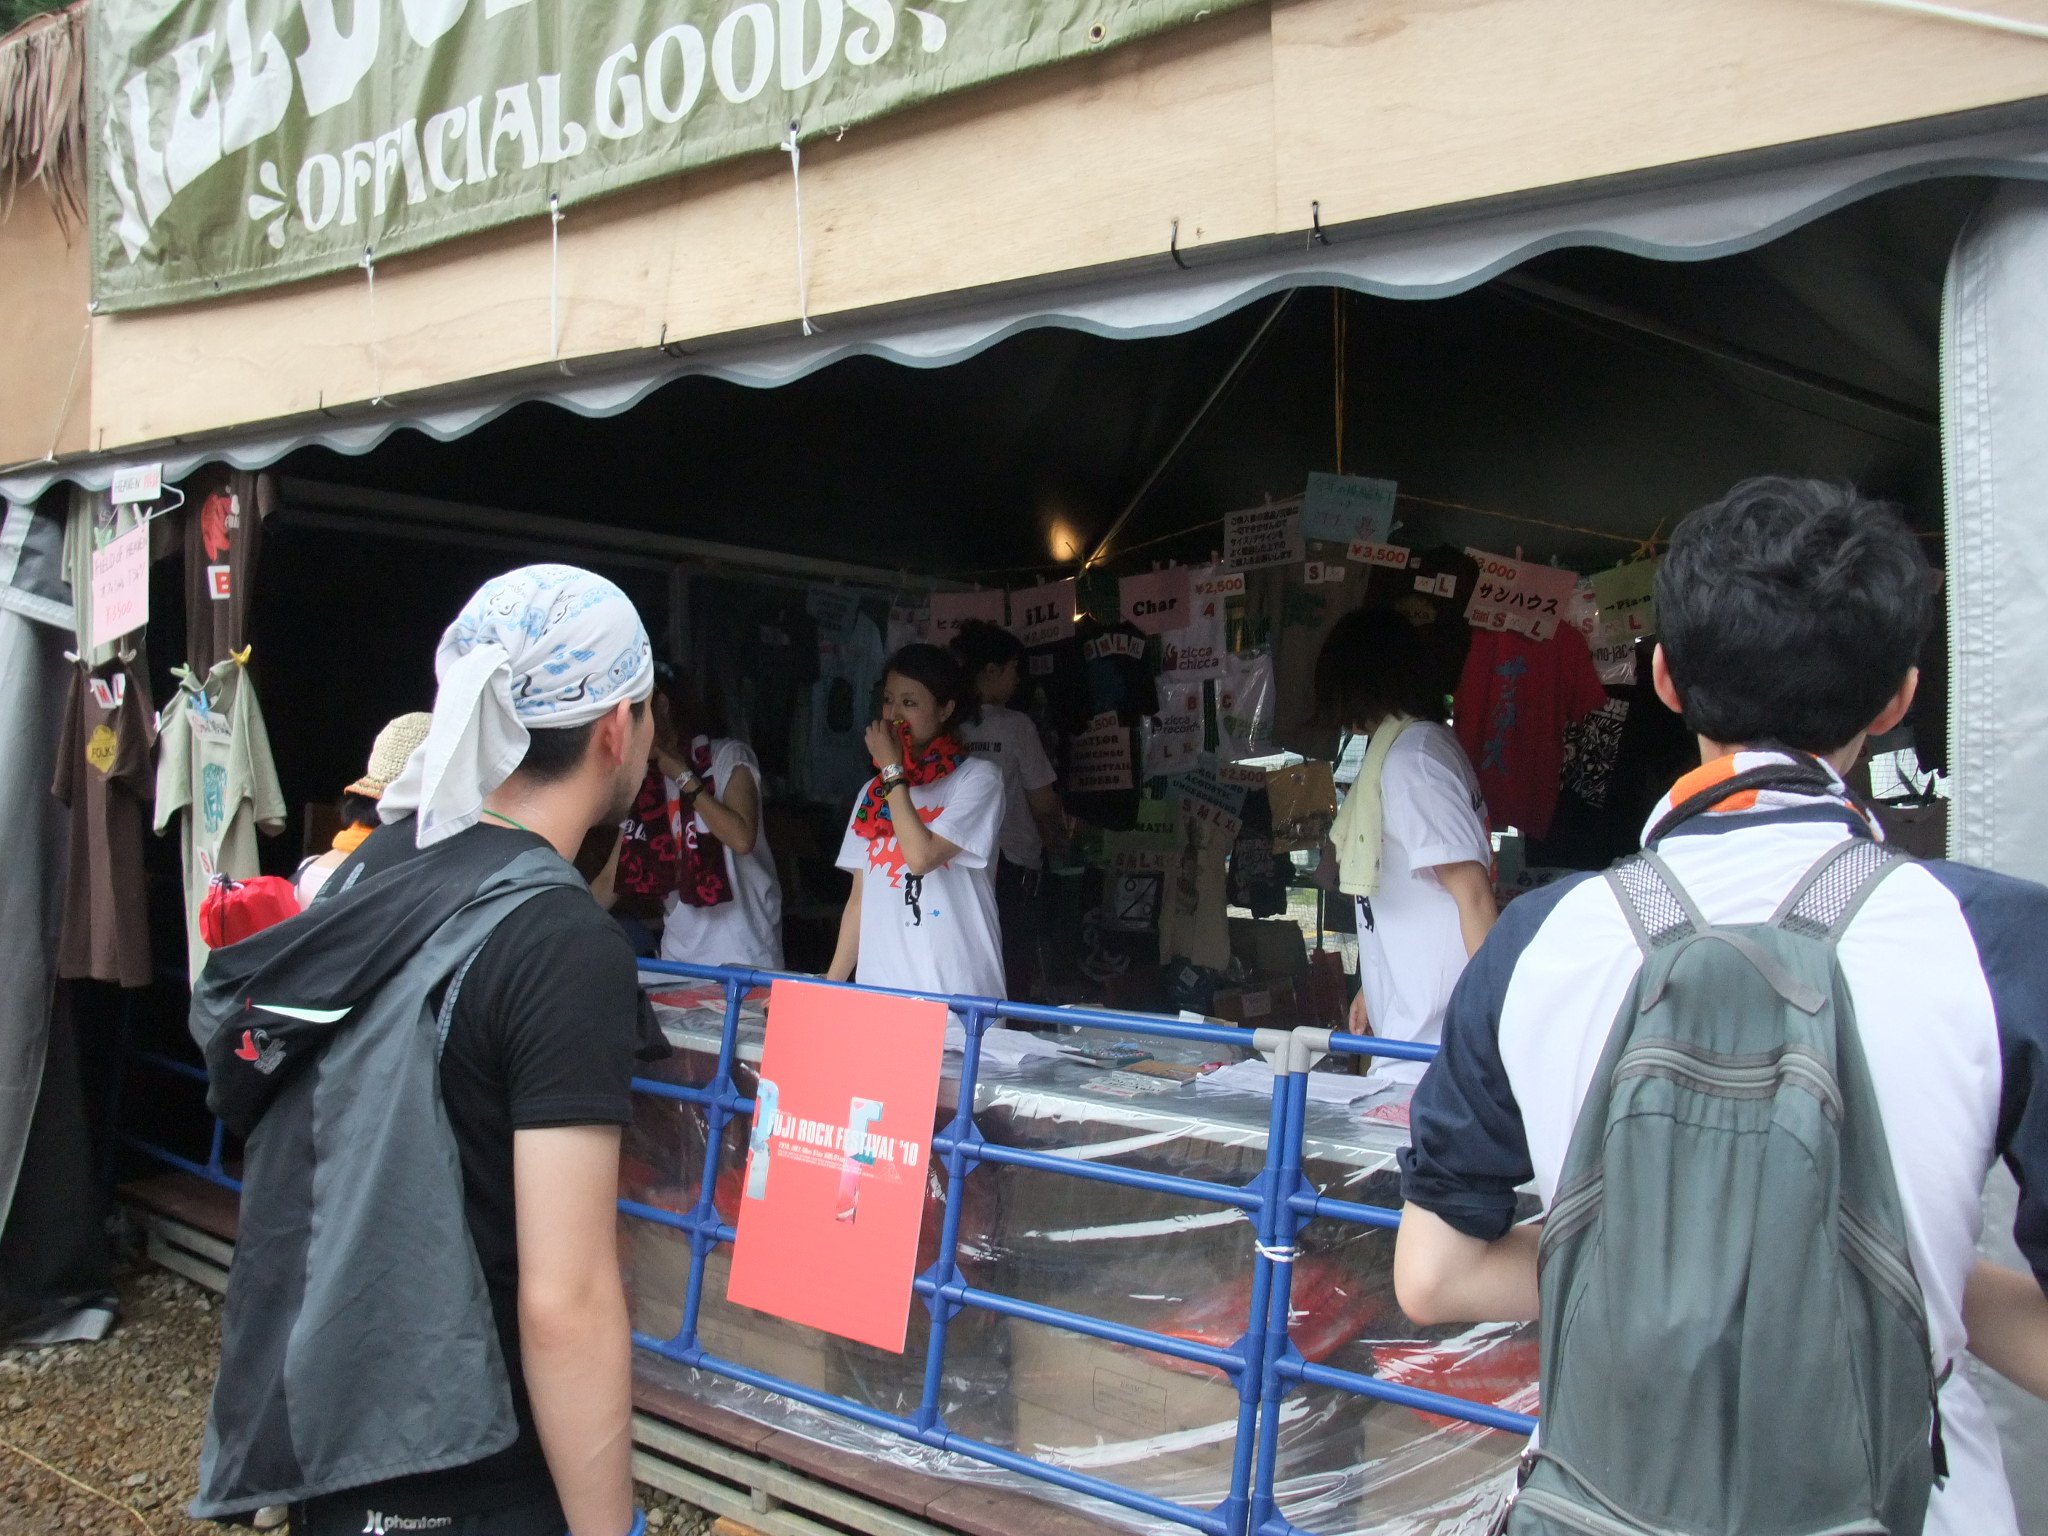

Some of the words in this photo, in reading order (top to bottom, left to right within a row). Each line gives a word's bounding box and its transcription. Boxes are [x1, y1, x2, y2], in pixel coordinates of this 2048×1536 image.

[297, 73, 587, 232] OFFICIAL
[595, 0, 895, 139] GOODS
[1351, 544, 1406, 563] ¥3,500
[1309, 566, 1319, 580] S
[1477, 557, 1517, 580] 3,000
[1195, 578, 1243, 595] ¥2,500
[1439, 577, 1449, 593] L
[1479, 582, 1559, 615] サンハウス
[1025, 602, 1060, 626] iLL
[1132, 598, 1177, 617] Char
[1202, 602, 1216, 618] A
[1492, 612, 1507, 628] S
[1582, 617, 1594, 634] S
[1628, 614, 1641, 630] L
[1530, 620, 1542, 637] L
[1116, 636, 1126, 651] L
[1180, 646, 1213, 658] zicca
[1178, 656, 1220, 671] chicca
[1088, 716, 1117, 732] ,500
[1164, 716, 1191, 725] zicca
[1219, 767, 1264, 783] ¥2,500
[1197, 805, 1210, 820] M
[1212, 811, 1221, 826] L
[768, 1111, 797, 1139] FUJI
[797, 1118, 835, 1150] ROCK
[835, 1126, 896, 1162] FESTIVAL
[899, 1137, 919, 1167] '10
[384, 1513, 452, 1532] phantom
